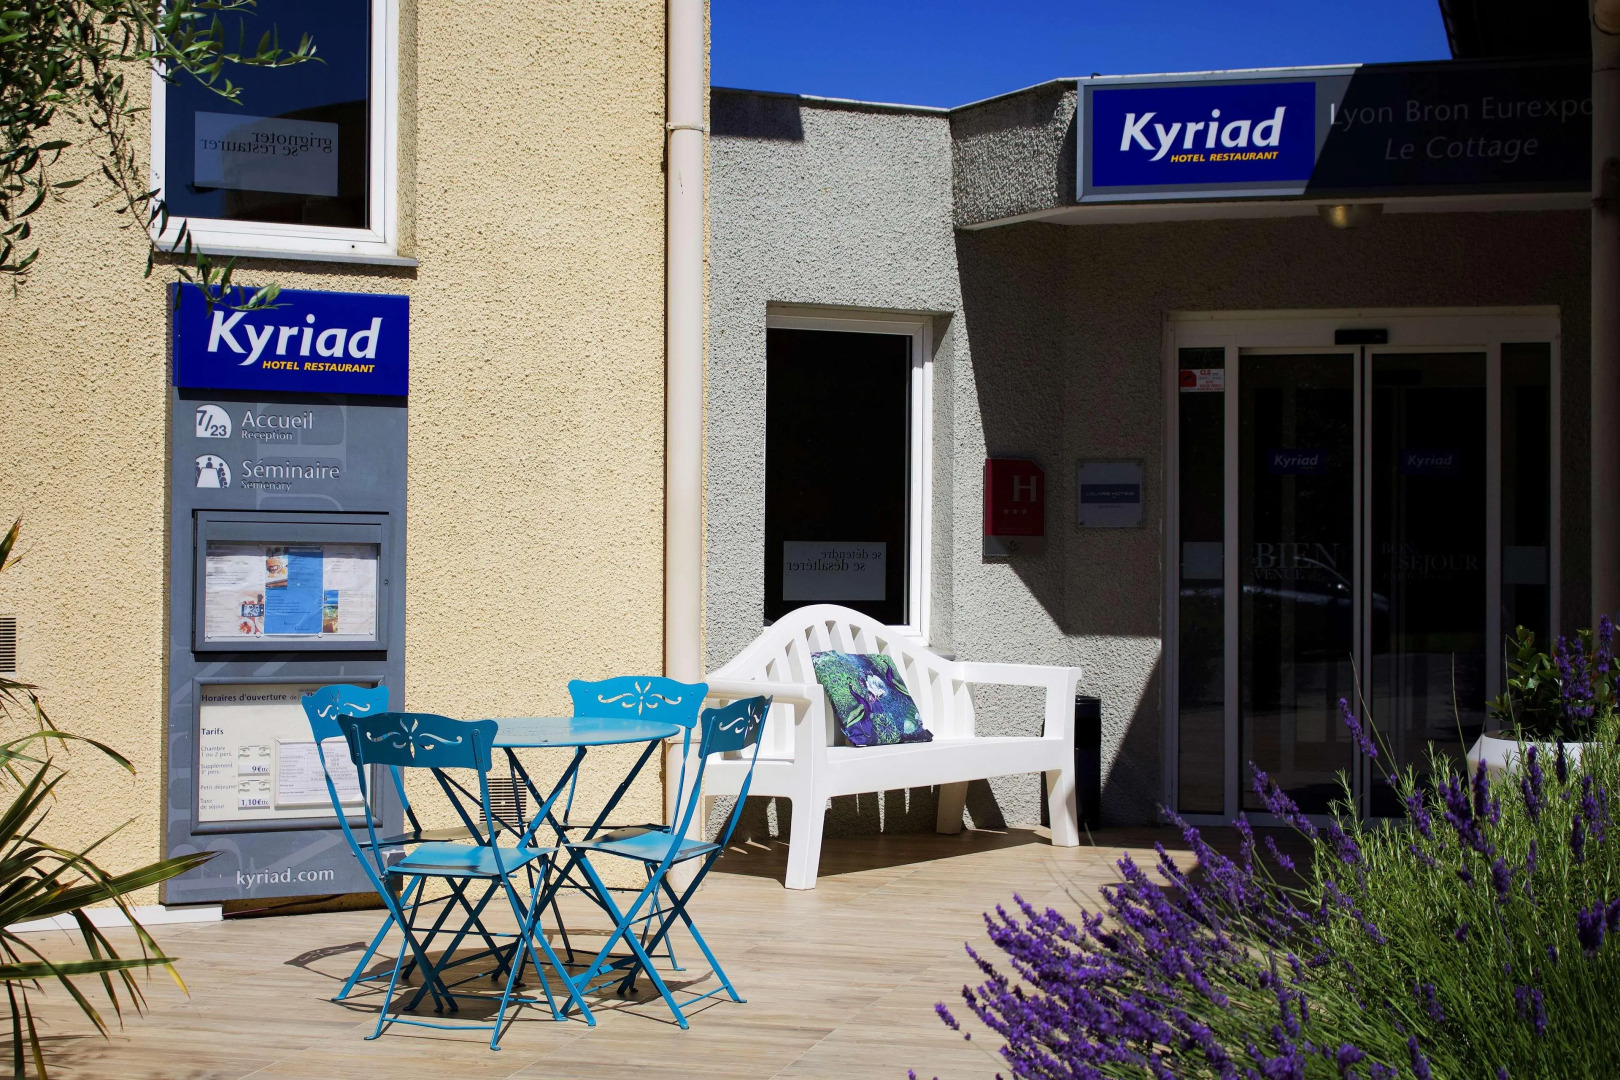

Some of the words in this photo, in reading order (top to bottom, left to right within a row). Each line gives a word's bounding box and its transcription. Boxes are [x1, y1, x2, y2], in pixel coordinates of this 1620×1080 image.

[1330, 102, 1393, 132] Lyon
[1406, 100, 1469, 122] Bron
[1482, 96, 1592, 123] Eurexpo
[1120, 106, 1287, 162] Kyriad
[1170, 154, 1206, 163] HOTEL
[1209, 151, 1279, 162] RESTAURANT
[1384, 138, 1415, 160] Le
[1426, 135, 1539, 164] Cottage
[207, 310, 383, 366] Kyriad
[262, 360, 300, 371] HOTEL
[304, 362, 375, 373] RESTAURANT
[196, 410, 227, 437] 7/23
[241, 410, 314, 429] Accueil
[241, 430, 293, 442] Reception
[242, 459, 340, 480] Séminaire
[1273, 454, 1319, 468] Kyriad
[1408, 454, 1453, 468] Kyriad
[241, 480, 292, 492] Semenary
[1012, 475, 1037, 502] H
[1255, 542, 1341, 569] BIEN
[201, 694, 237, 702] Horaires
[239, 693, 287, 701] d'ouverture
[236, 867, 334, 889] kyriad.com
